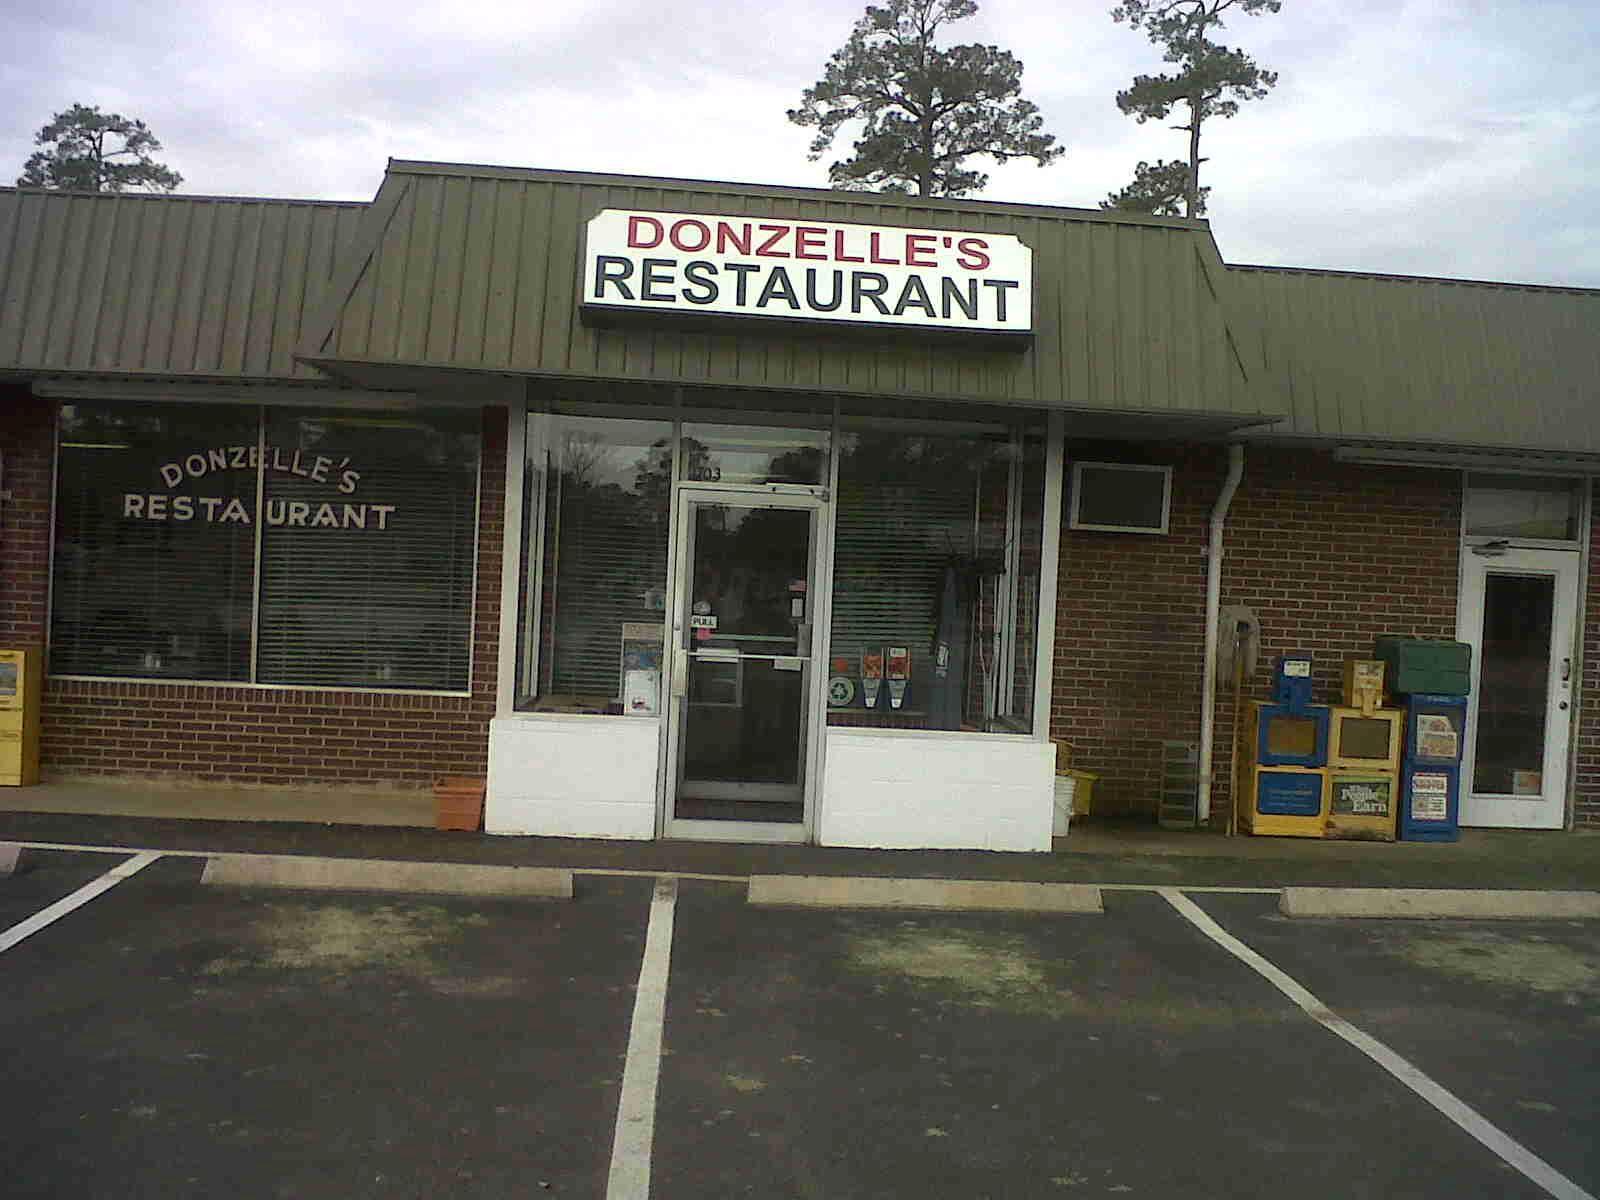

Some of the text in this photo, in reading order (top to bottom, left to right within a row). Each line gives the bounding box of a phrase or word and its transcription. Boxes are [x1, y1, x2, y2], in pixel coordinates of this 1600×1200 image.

[627, 215, 991, 271] DONZELLE'S
[593, 255, 1019, 322] RESTAURANT
[159, 446, 361, 495] DONZELLE'S
[693, 615, 714, 627] PULL
